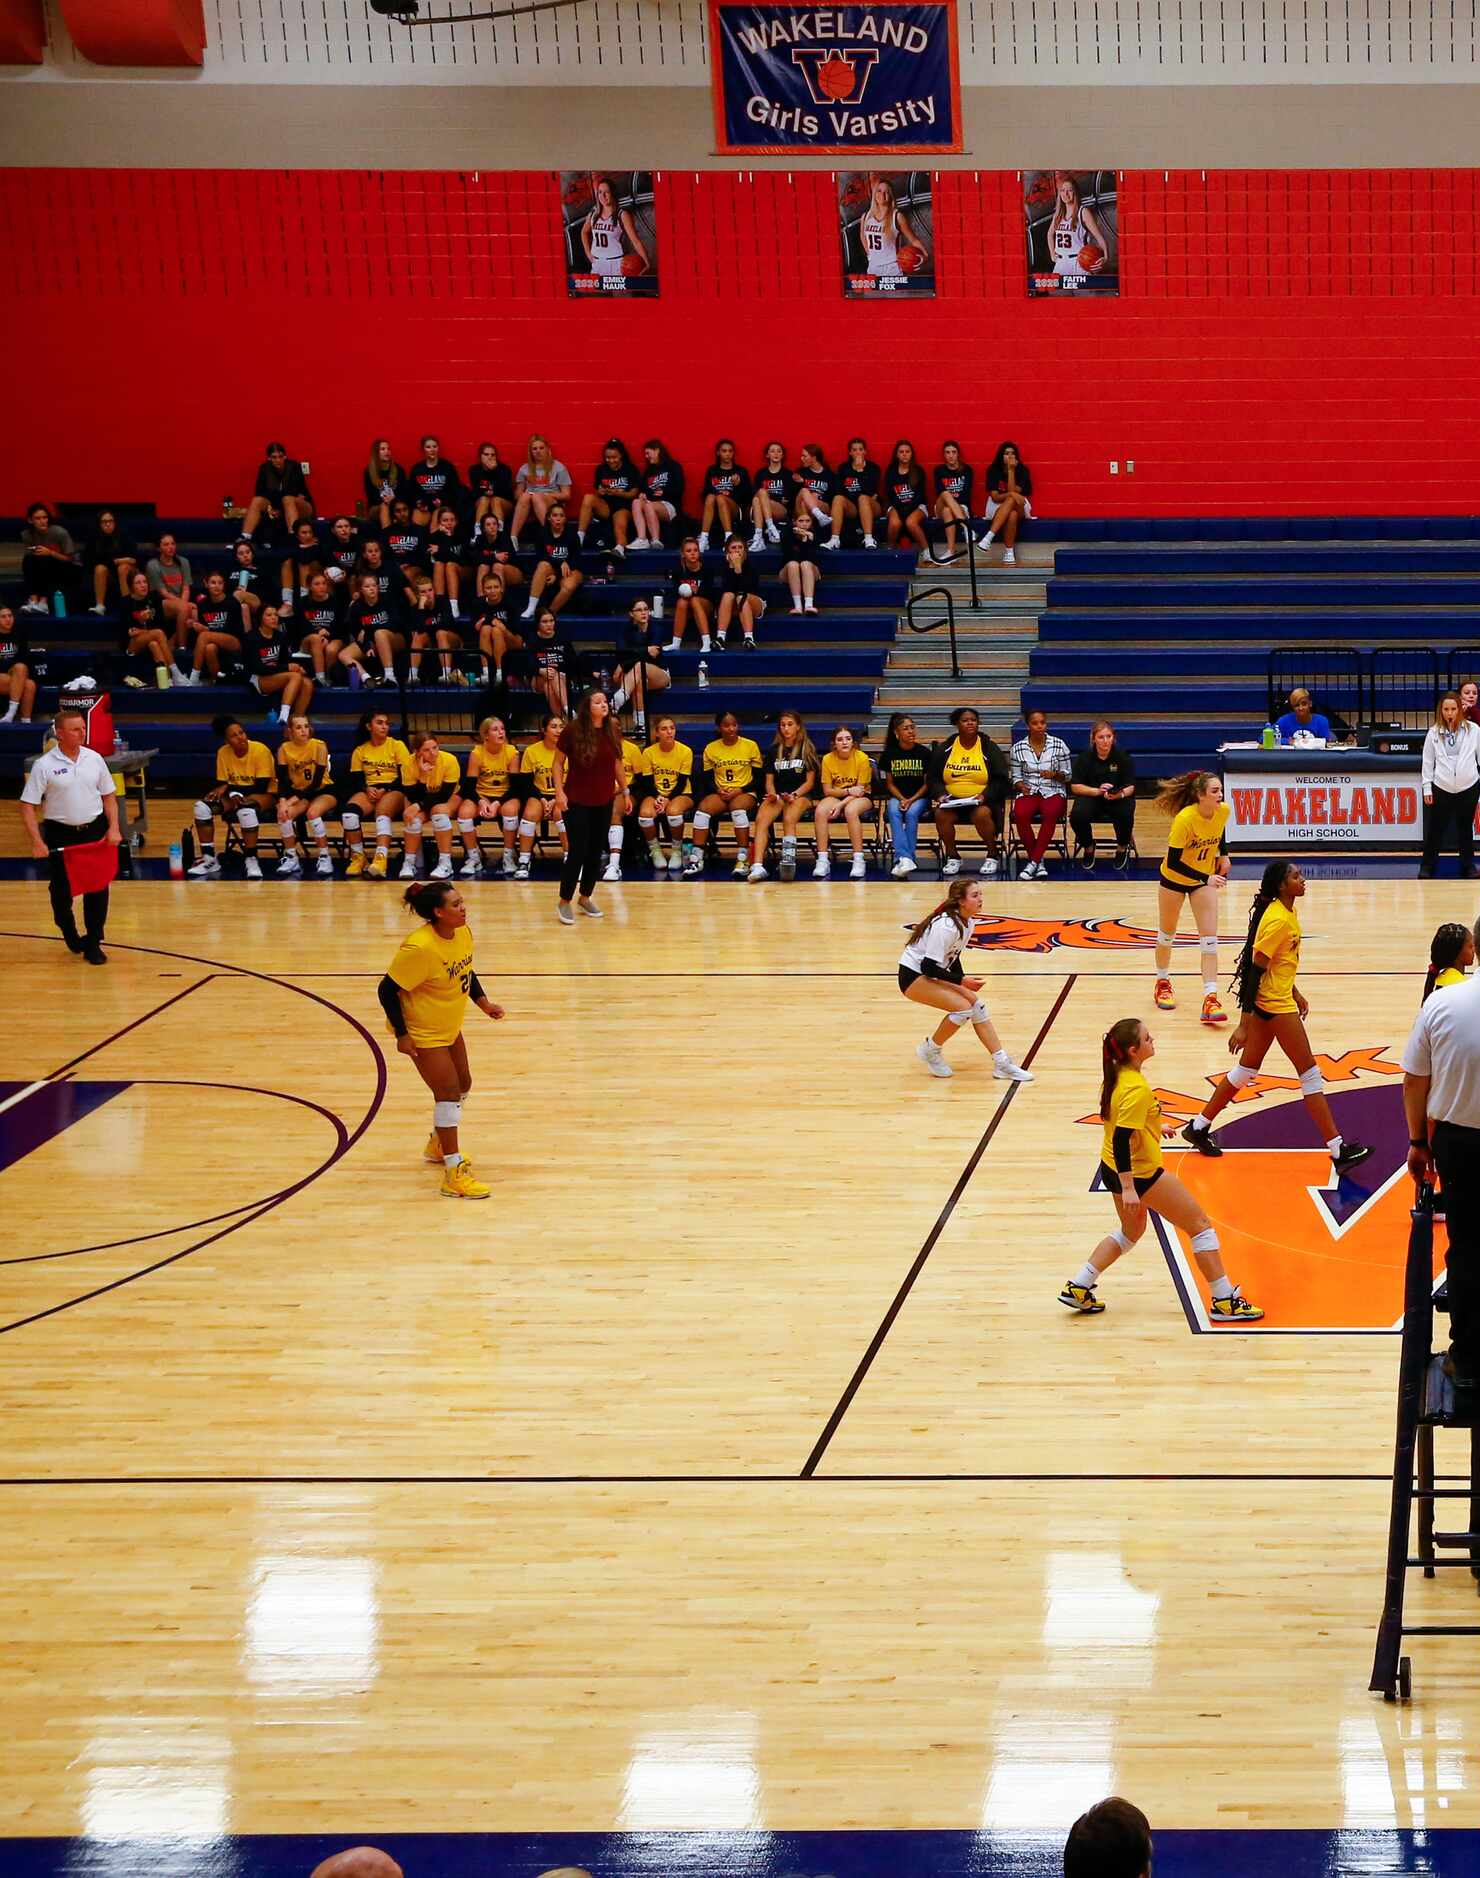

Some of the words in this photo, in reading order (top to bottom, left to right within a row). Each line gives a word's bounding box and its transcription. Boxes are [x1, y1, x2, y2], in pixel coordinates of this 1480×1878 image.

[737, 12, 929, 54] WAKELAND
[746, 96, 819, 136] Girls
[829, 96, 936, 137] Varsity
[595, 233, 608, 248] 10
[869, 234, 882, 251] 15
[1057, 233, 1072, 249] 23
[603, 283, 626, 291] HAUK
[879, 283, 896, 291] FOX
[1063, 282, 1078, 290] LEE
[891, 760, 924, 769] MEMORIAL
[725, 769, 734, 782] 6
[1295, 776, 1338, 784] WELCOME
[1340, 776, 1351, 784] TO
[1231, 787, 1419, 825] WAKELAND
[1288, 829, 1313, 838] HIGH
[1316, 828, 1359, 838] SCHOOL
[1197, 848, 1210, 861] 11
